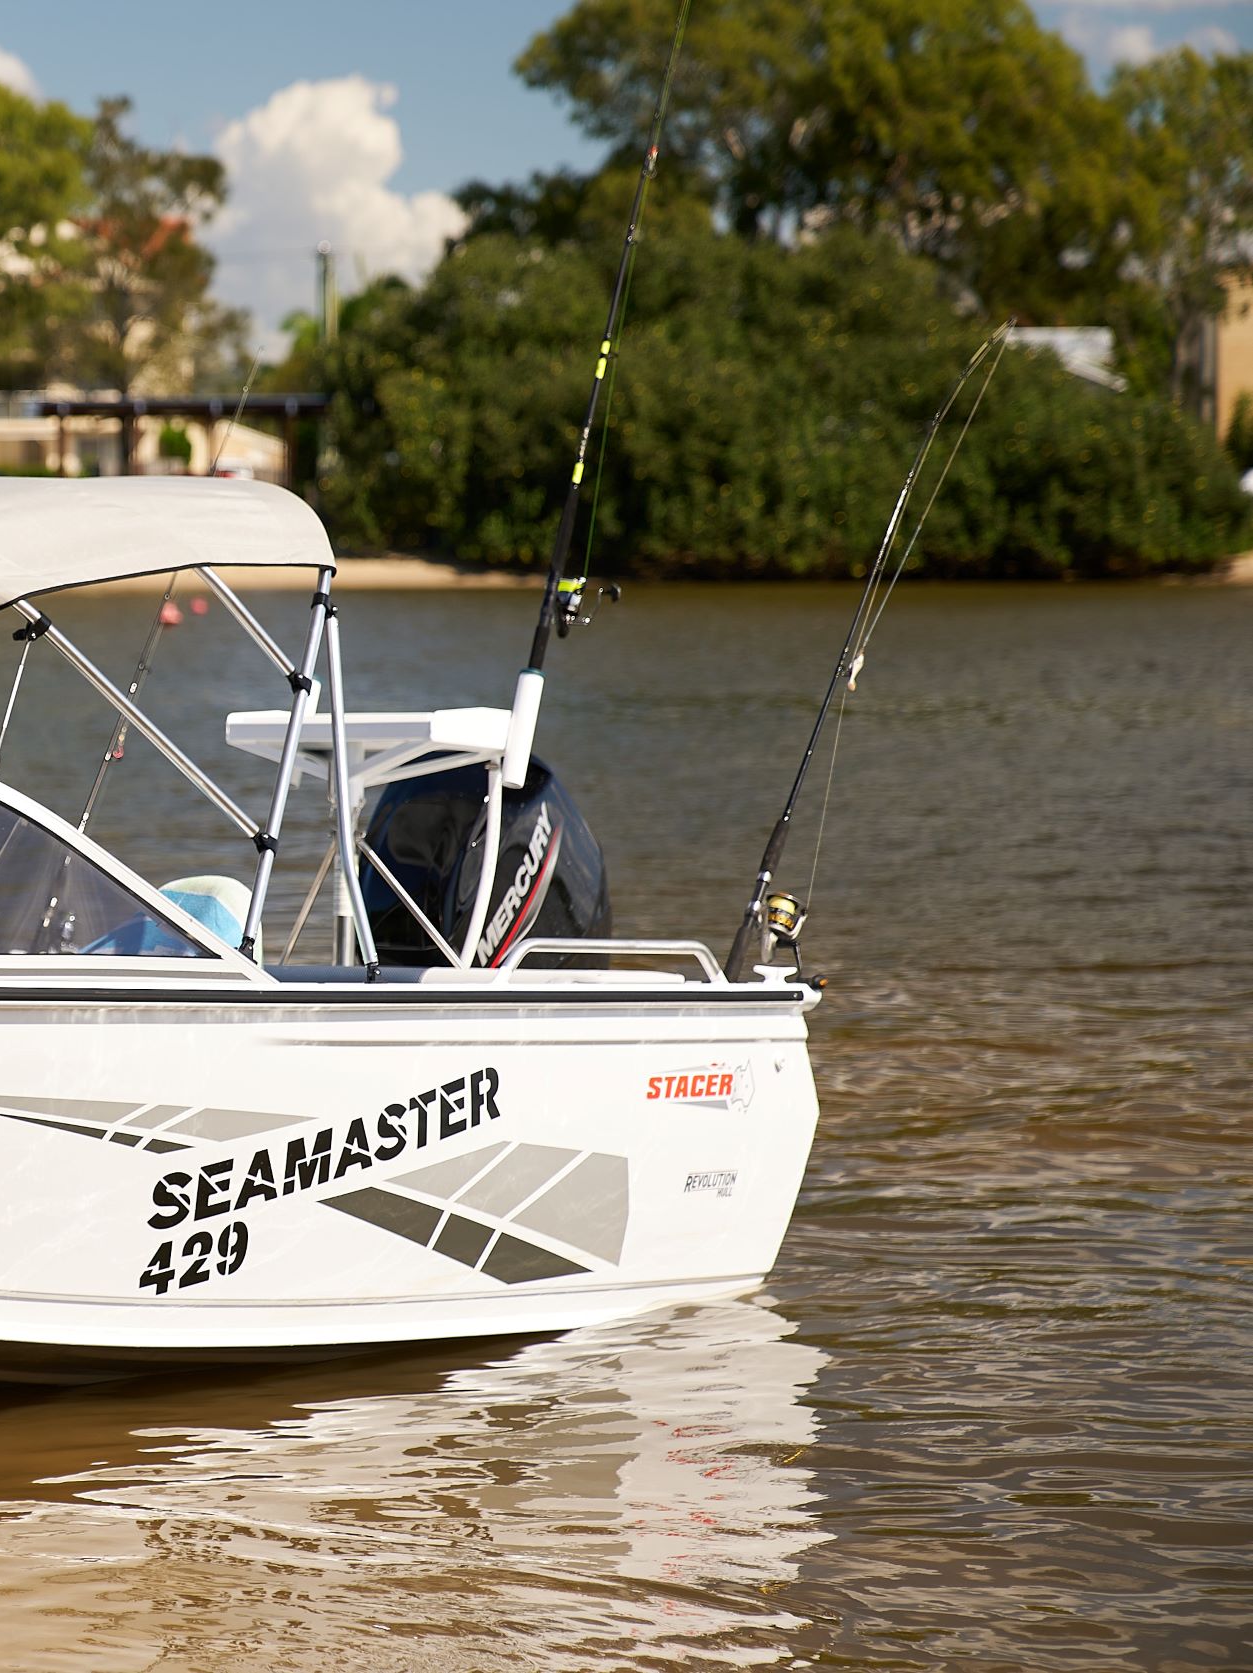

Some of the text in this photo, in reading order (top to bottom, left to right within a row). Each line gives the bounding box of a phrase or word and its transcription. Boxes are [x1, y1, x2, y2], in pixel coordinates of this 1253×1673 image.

[477, 801, 552, 968] MERCURY
[646, 1074, 734, 1100] STACER
[147, 1067, 501, 1230] SEAMASTER
[684, 1172, 738, 1193] REVOLUTION
[139, 1221, 249, 1296] 429
